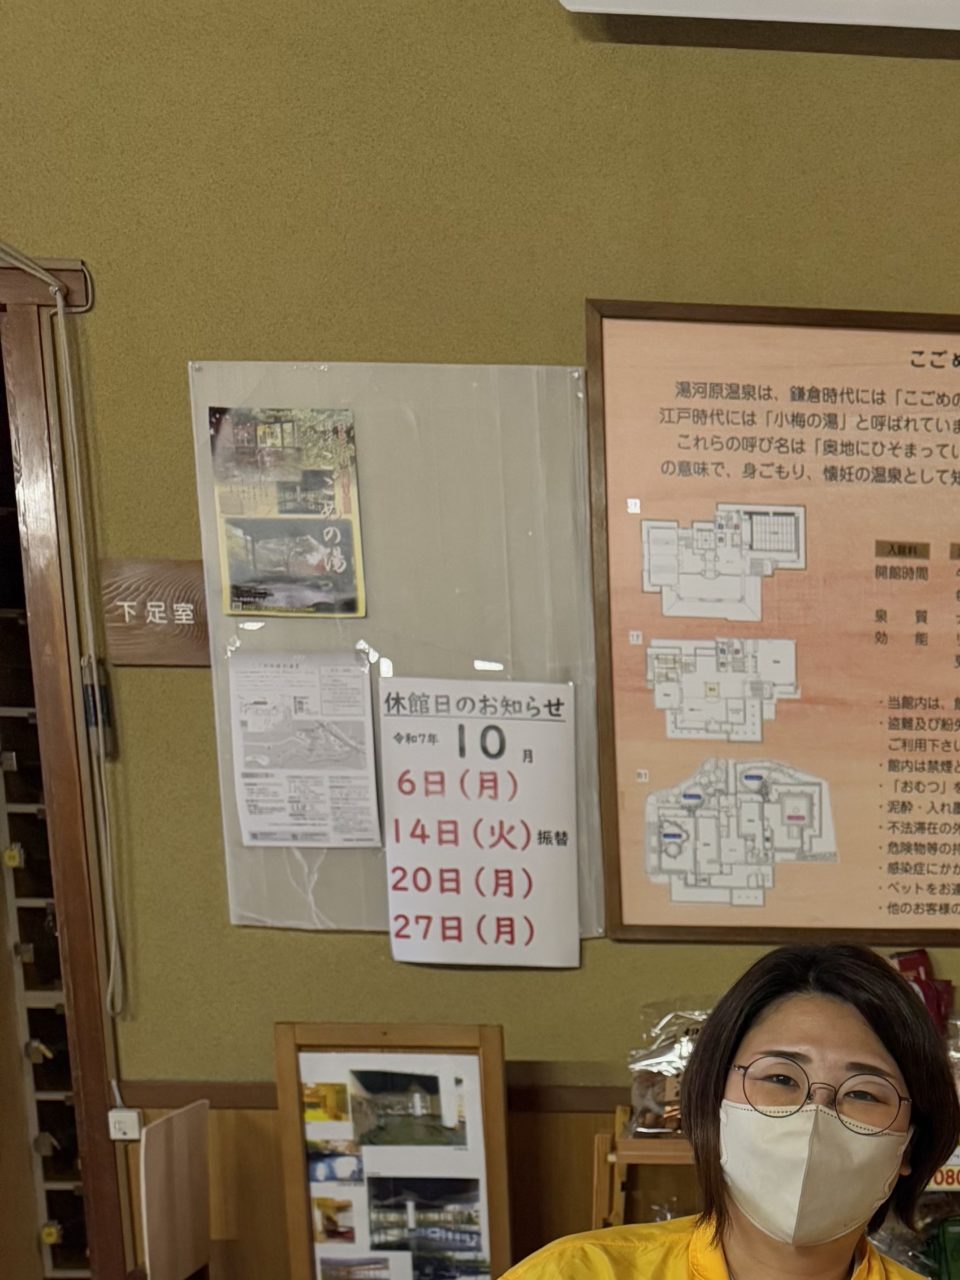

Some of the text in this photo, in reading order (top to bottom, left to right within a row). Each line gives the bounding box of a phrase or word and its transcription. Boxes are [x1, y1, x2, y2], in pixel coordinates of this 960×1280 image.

[875, 565, 929, 581] 開館時間
[116, 601, 195, 624] 下足室
[384, 691, 566, 718] 休館日のお知らせ
[393, 724, 534, 764] 令和7年 10 月
[397, 769, 519, 801] 6日（月）
[394, 819, 568, 851] 14日（火） 振替
[391, 866, 534, 900] 20日（月）
[393, 914, 536, 947] 27日（月）
